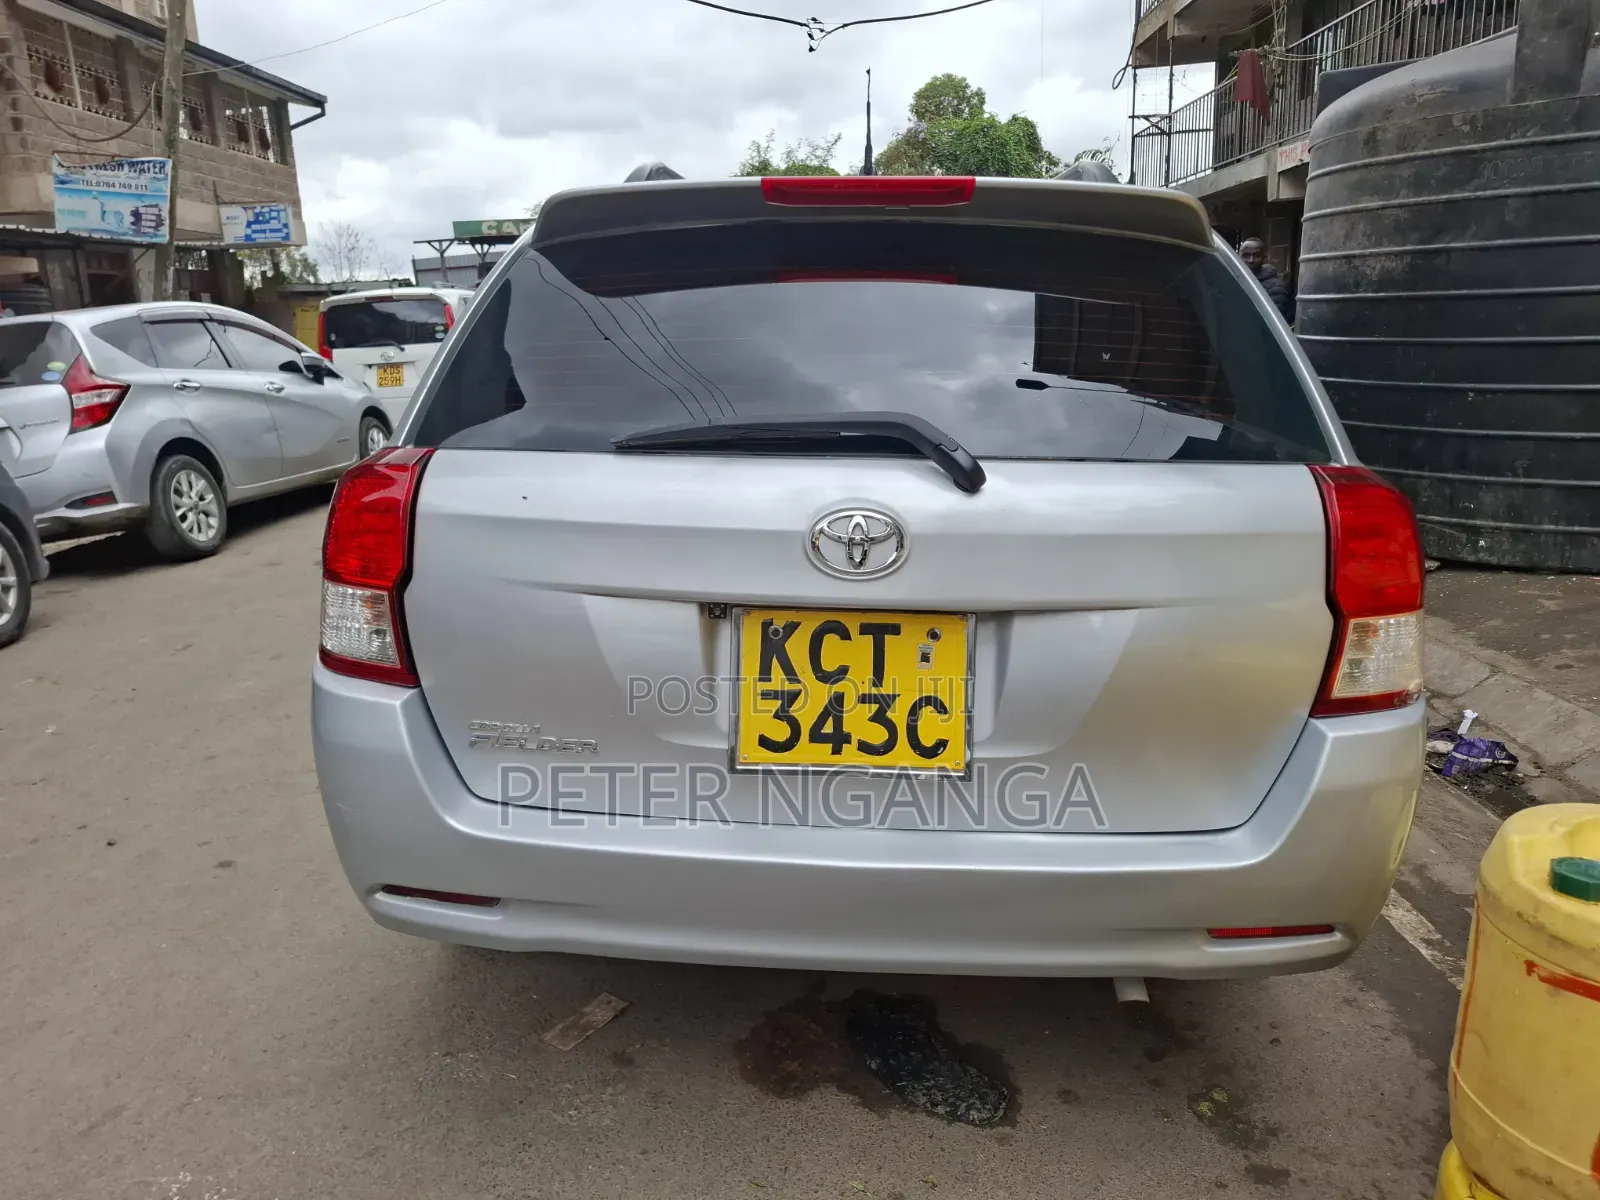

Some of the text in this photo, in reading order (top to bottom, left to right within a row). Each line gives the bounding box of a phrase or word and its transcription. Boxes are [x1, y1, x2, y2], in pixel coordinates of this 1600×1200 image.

[383, 364, 401, 375] KDS
[378, 376, 401, 386] 259H
[757, 617, 903, 688] KCT
[757, 688, 950, 760] 343C
[468, 733, 600, 754] FIELDER
